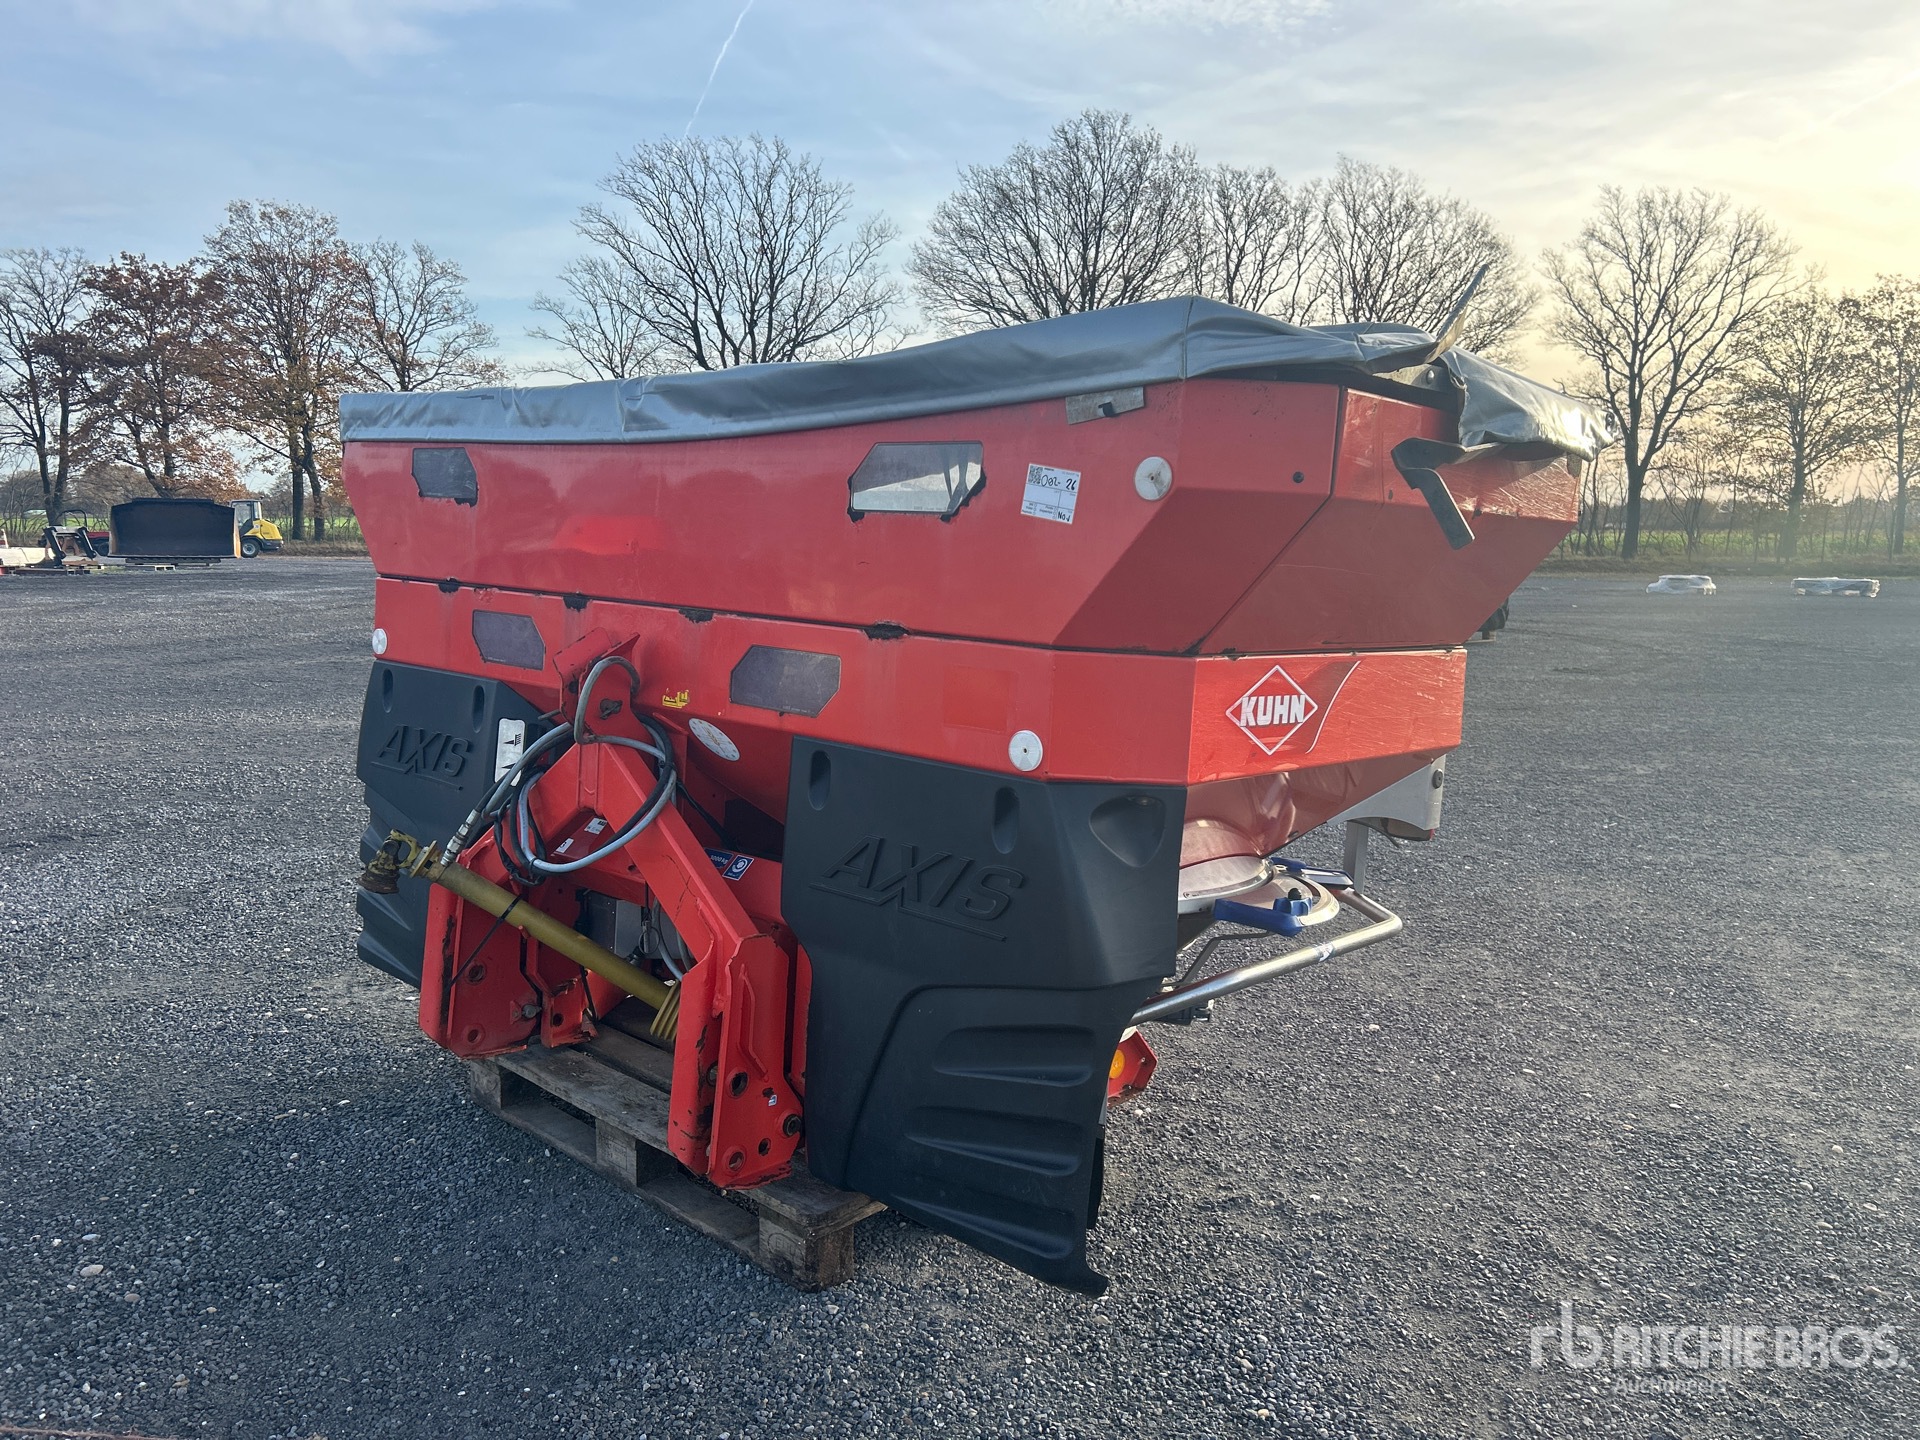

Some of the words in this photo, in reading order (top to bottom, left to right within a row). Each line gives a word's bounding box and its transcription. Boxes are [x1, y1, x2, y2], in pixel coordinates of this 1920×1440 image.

[1065, 478, 1077, 491] 26
[1239, 694, 1306, 727] KUHN
[378, 724, 472, 777] AXIS
[822, 833, 1026, 922] AXIS
